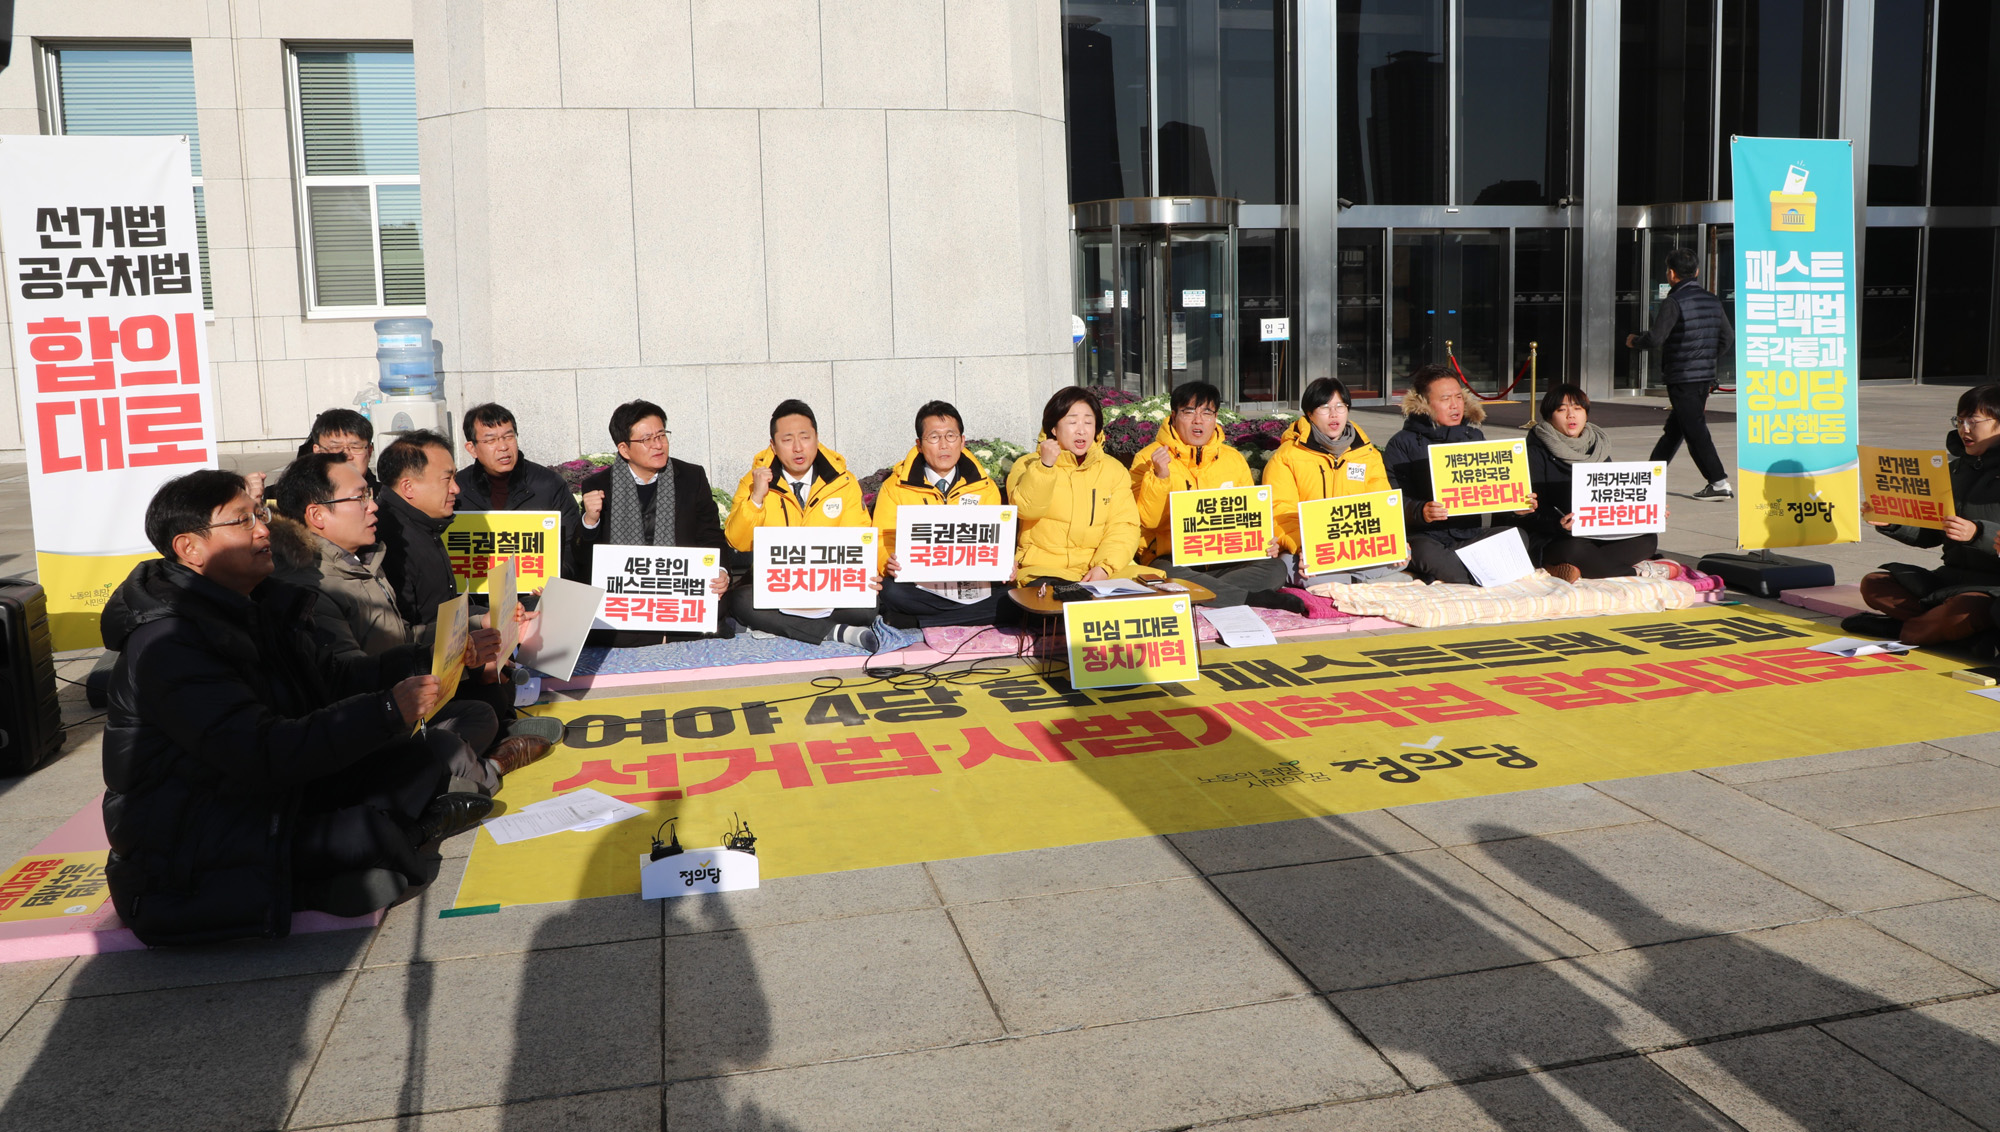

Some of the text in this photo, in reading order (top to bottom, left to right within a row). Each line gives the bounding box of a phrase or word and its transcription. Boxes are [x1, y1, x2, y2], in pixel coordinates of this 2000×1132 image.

[37, 206, 167, 249] 선거법
[19, 253, 192, 300] 공수처법
[1745, 250, 1845, 291] 패스트
[1746, 293, 1846, 334] 트랙법
[27, 312, 200, 393] 합의
[1746, 337, 1847, 368] 즉각통과
[1746, 370, 1848, 411] 정의당
[36, 393, 208, 474] 대로
[1748, 413, 1846, 445] 비상행동
[1445, 451, 1513, 469] 개혁거부세력
[1879, 456, 1920, 476] 선거법
[1348, 467, 1365, 477] 정의당
[1452, 467, 1510, 484] 자유한국당
[1587, 471, 1652, 487] 개혁거부세력
[1441, 482, 1525, 508] 규탄한다!
[1591, 488, 1647, 503] 자유한국당
[1876, 474, 1931, 496] 공수처법
[1196, 495, 1247, 515] 4당 합의
[1330, 502, 1371, 519] 선거법
[1579, 504, 1658, 527] 규탄한다!
[1787, 502, 1835, 524] 정의당
[1870, 494, 1944, 522] 합의대로!
[910, 522, 1000, 544] 특권철폐
[1183, 511, 1262, 533] 패스트트랙법
[1327, 518, 1381, 540] 공수처법
[448, 531, 544, 554] 특권철폐
[1183, 530, 1264, 557] 즉각통과
[1315, 534, 1397, 565] 동시처리
[770, 545, 863, 565] 민심 그대로
[909, 545, 999, 567] 국회개혁
[624, 557, 689, 577] 4당 합의
[607, 576, 705, 597] 패스트트랙법
[766, 567, 866, 592] 정치개혁
[70, 588, 110, 600] 노동의 희망
[604, 597, 707, 623] 즉각통과
[1083, 616, 1180, 642] 민심 그대로
[1083, 639, 1187, 672] 정치개혁
[563, 701, 783, 749] 여야
[804, 685, 967, 726] 4당
[1197, 631, 1650, 692] 패스트트랙
[1609, 616, 1814, 650] 통과
[1483, 647, 1928, 711] 합의대로!
[1197, 765, 1304, 784] 노동의 희망
[1329, 743, 1538, 784] 정의당
[1248, 771, 1331, 788] 시민의 꿈
[20, 862, 97, 908] 공수처법
[679, 867, 722, 887] 정의당
